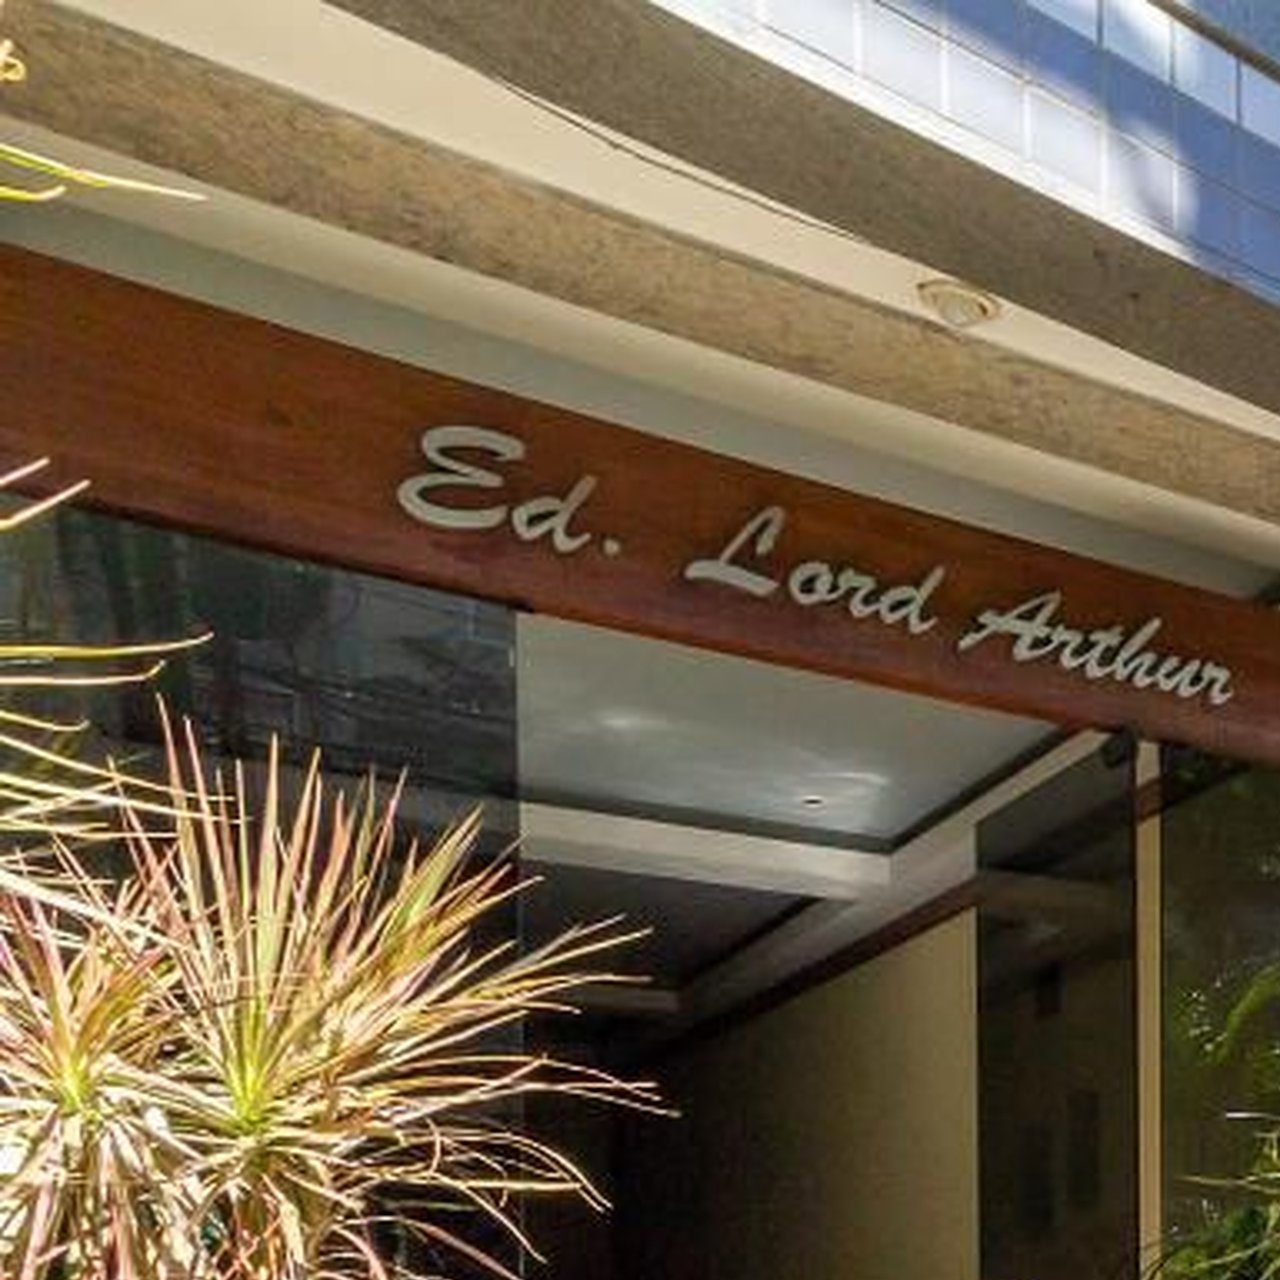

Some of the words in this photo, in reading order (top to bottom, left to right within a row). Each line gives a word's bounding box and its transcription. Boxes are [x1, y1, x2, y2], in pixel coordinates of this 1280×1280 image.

[397, 425, 621, 556] Ed.
[684, 506, 946, 636] Lord
[958, 592, 1236, 707] Arthur
